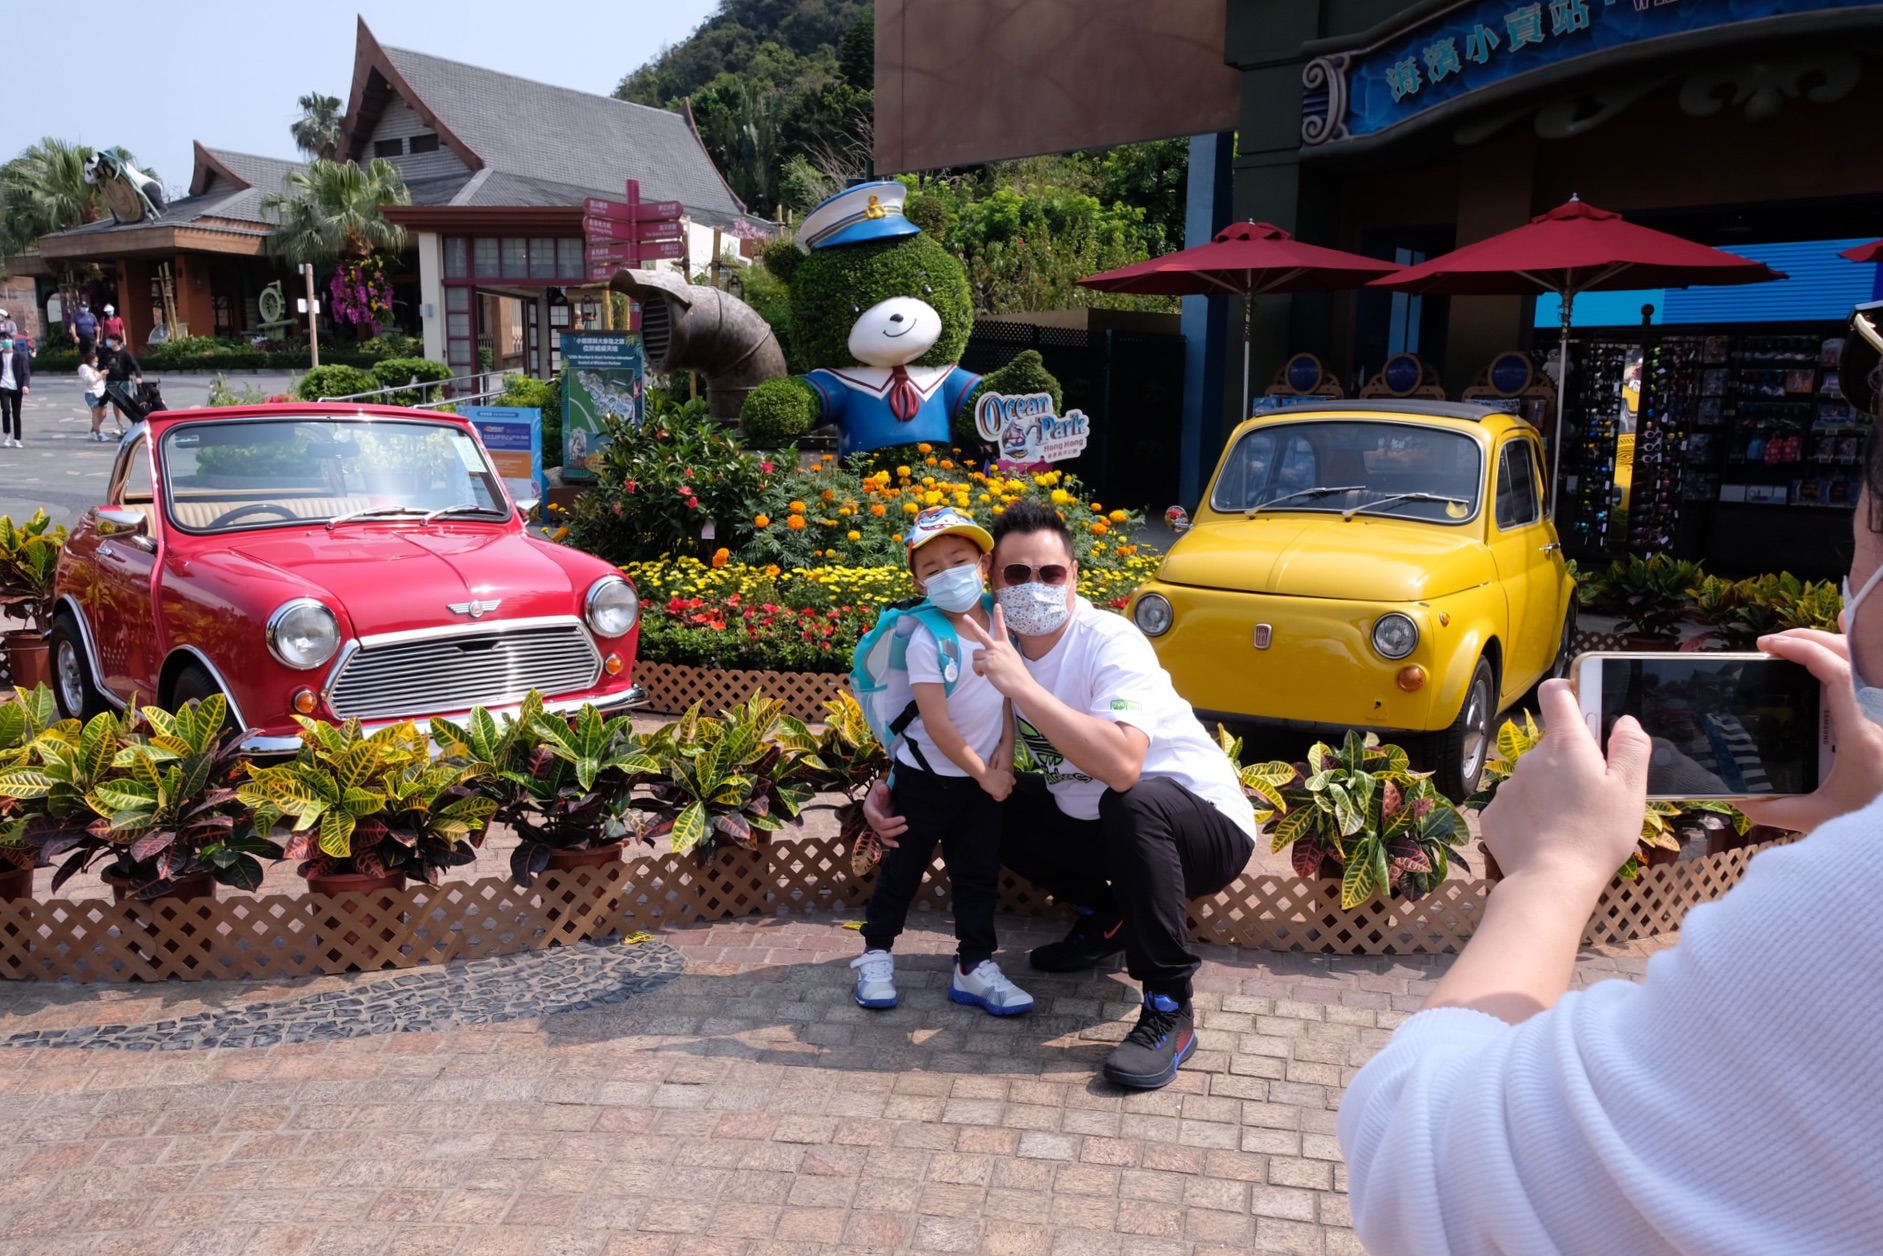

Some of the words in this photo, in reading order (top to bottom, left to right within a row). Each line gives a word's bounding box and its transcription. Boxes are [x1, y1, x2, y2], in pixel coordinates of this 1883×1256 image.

[1386, 0, 1590, 102] 海濱小賣站
[979, 394, 1049, 438] Ocean
[1036, 411, 1086, 446] Park
[1044, 443, 1063, 452] Hong
[1064, 439, 1084, 449] Kong
